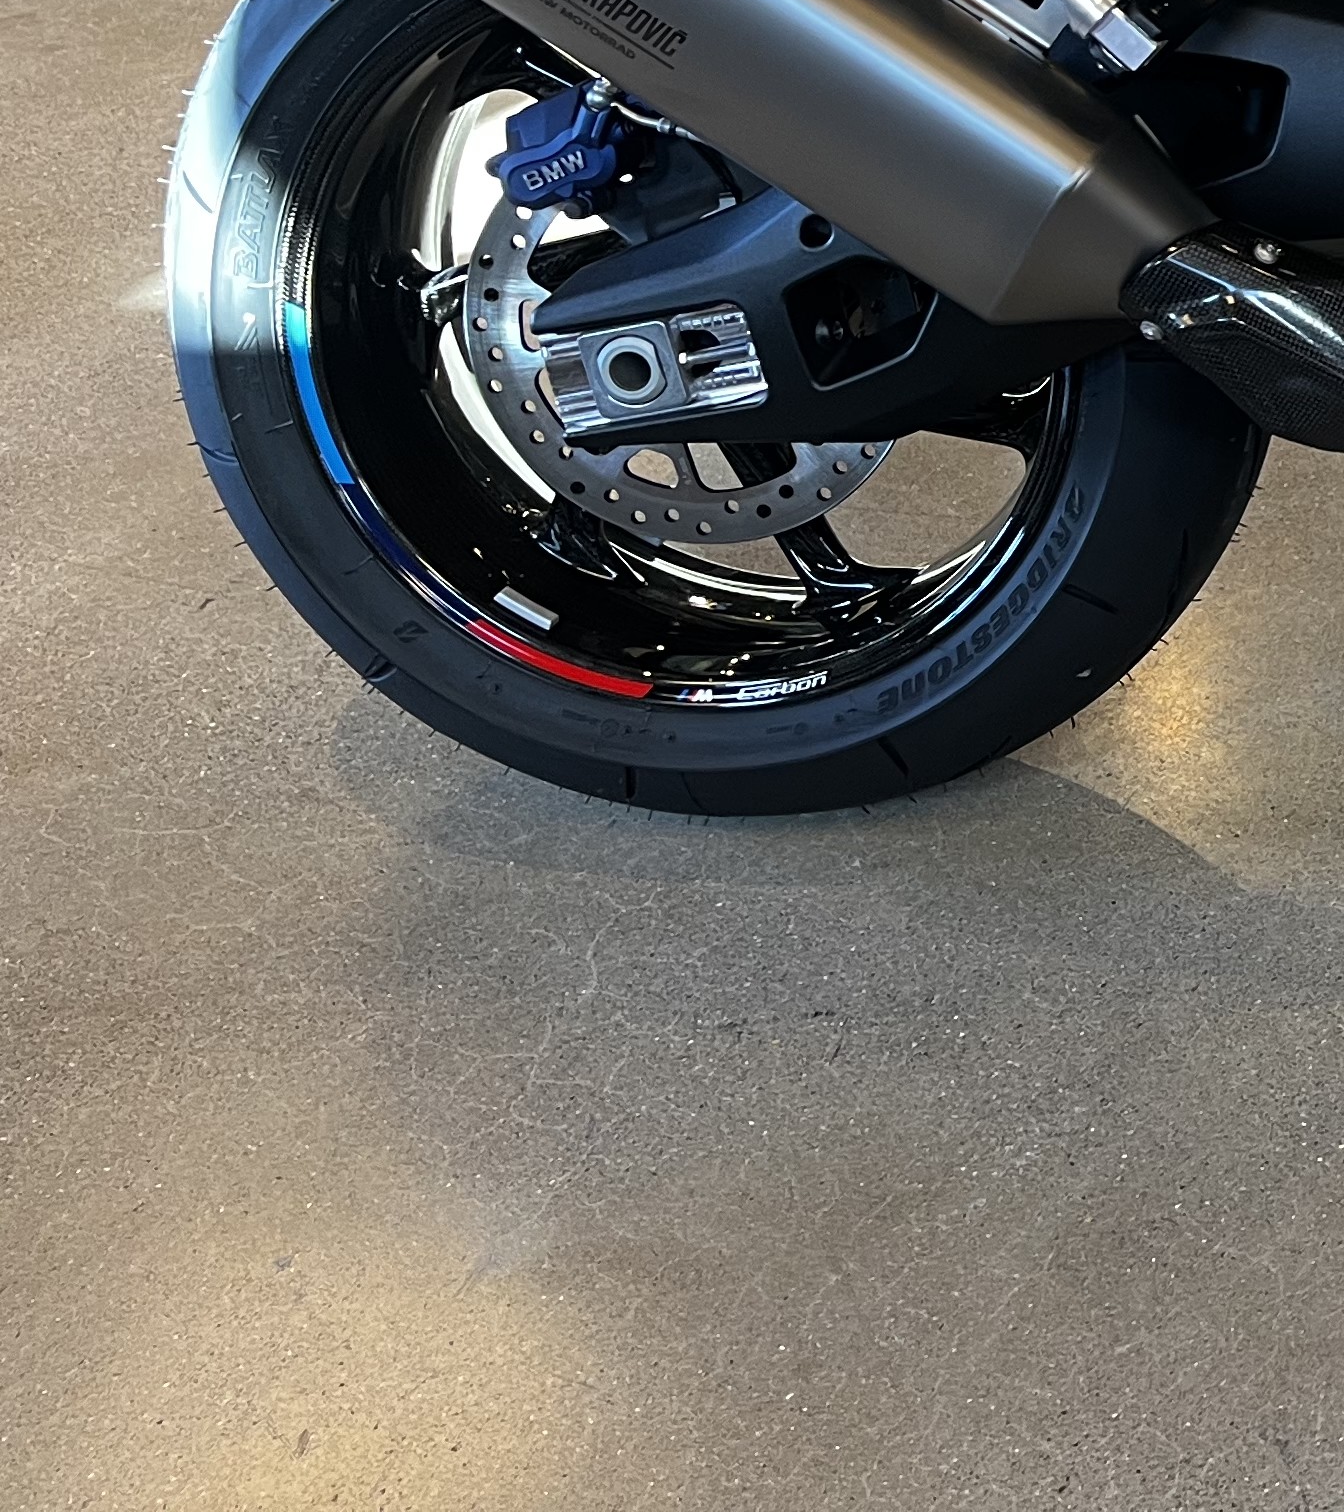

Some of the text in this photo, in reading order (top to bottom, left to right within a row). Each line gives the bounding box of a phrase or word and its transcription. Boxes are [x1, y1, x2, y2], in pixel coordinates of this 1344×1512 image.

[560, 7, 637, 60] MOTORRAD
[523, 150, 585, 190] BMW
[736, 670, 828, 701] Carbon
